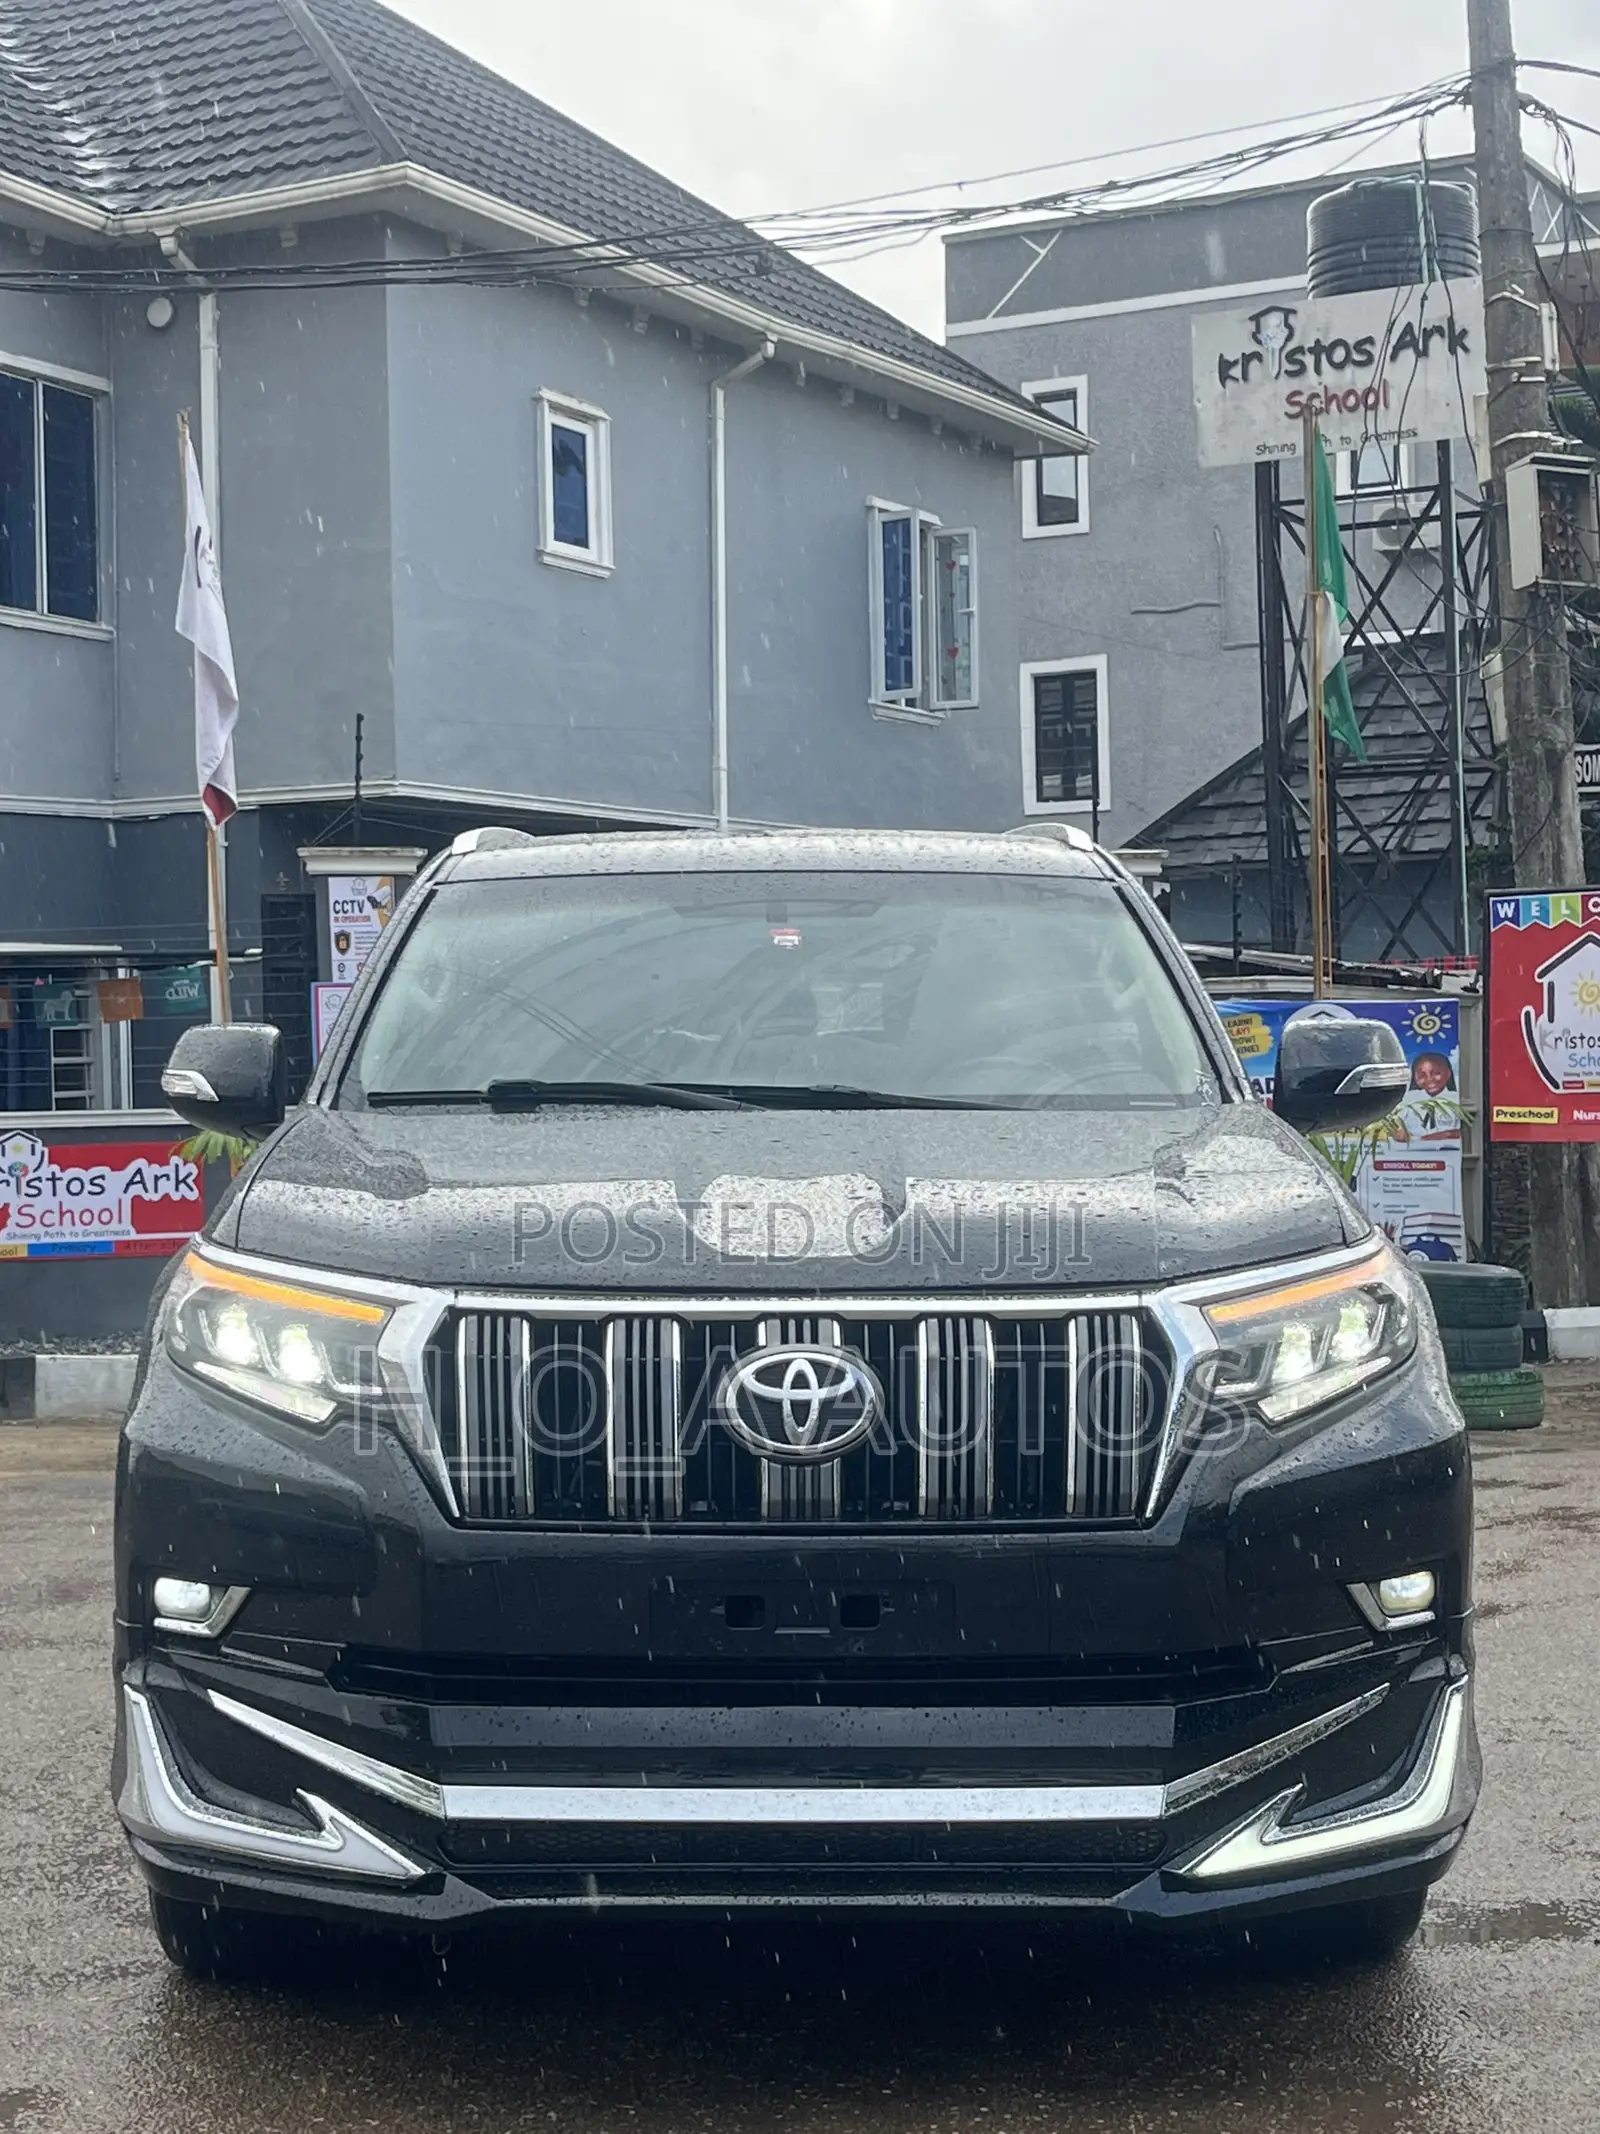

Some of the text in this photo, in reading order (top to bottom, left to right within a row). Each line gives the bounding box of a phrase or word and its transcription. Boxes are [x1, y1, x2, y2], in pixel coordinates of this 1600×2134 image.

[1390, 315, 1470, 362] Ark
[333, 899, 365, 914] CCTV
[1495, 1109, 1554, 1119] Preschool
[123, 1163, 195, 1194] Ark
[15, 1198, 123, 1229] School
[6, 1229, 131, 1241] Shining Path to Greatness
